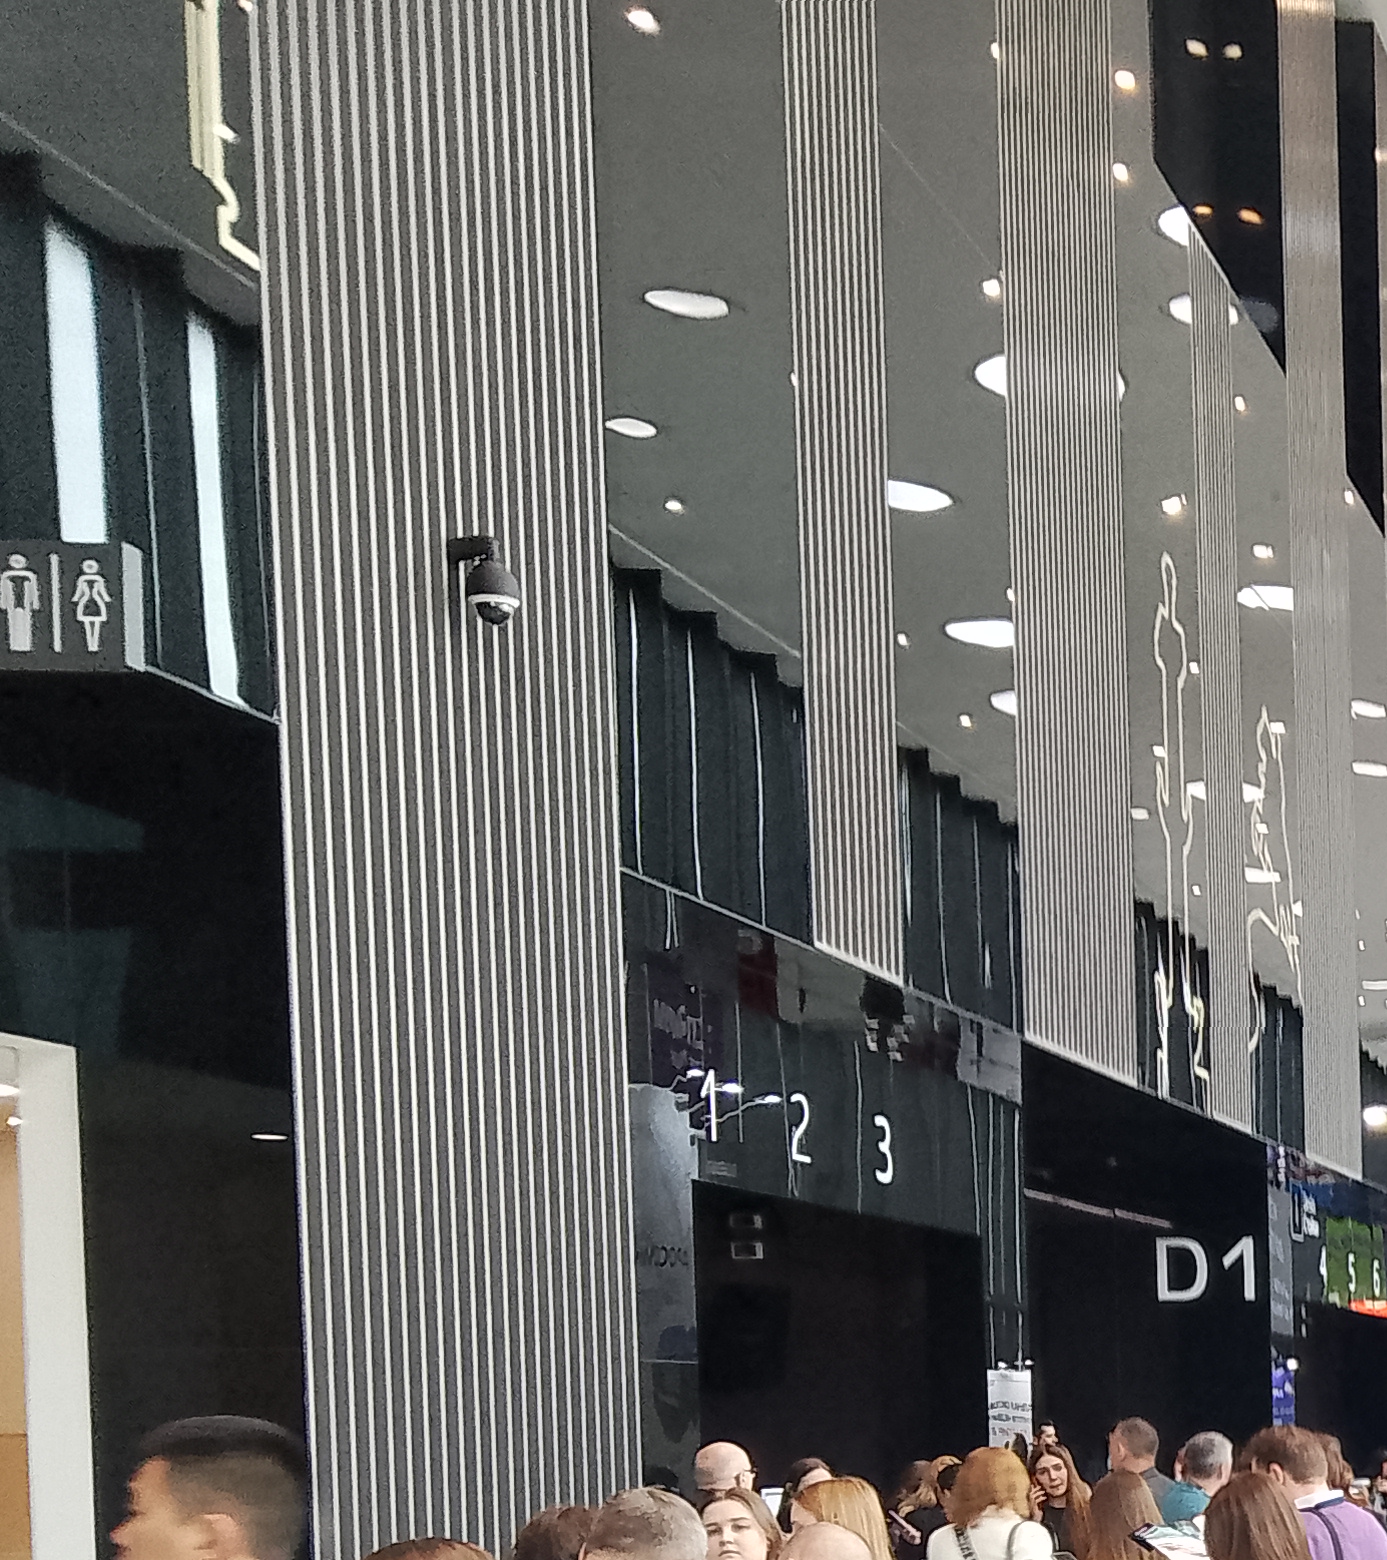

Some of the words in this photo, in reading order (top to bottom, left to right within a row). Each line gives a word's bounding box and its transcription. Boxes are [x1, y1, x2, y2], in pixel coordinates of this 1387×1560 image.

[700, 1068, 718, 1142] 1
[790, 1093, 812, 1164] 2
[874, 1115, 894, 1185] 3
[1155, 1234, 1256, 1303] D1
[1373, 1258, 1381, 1297] 6
